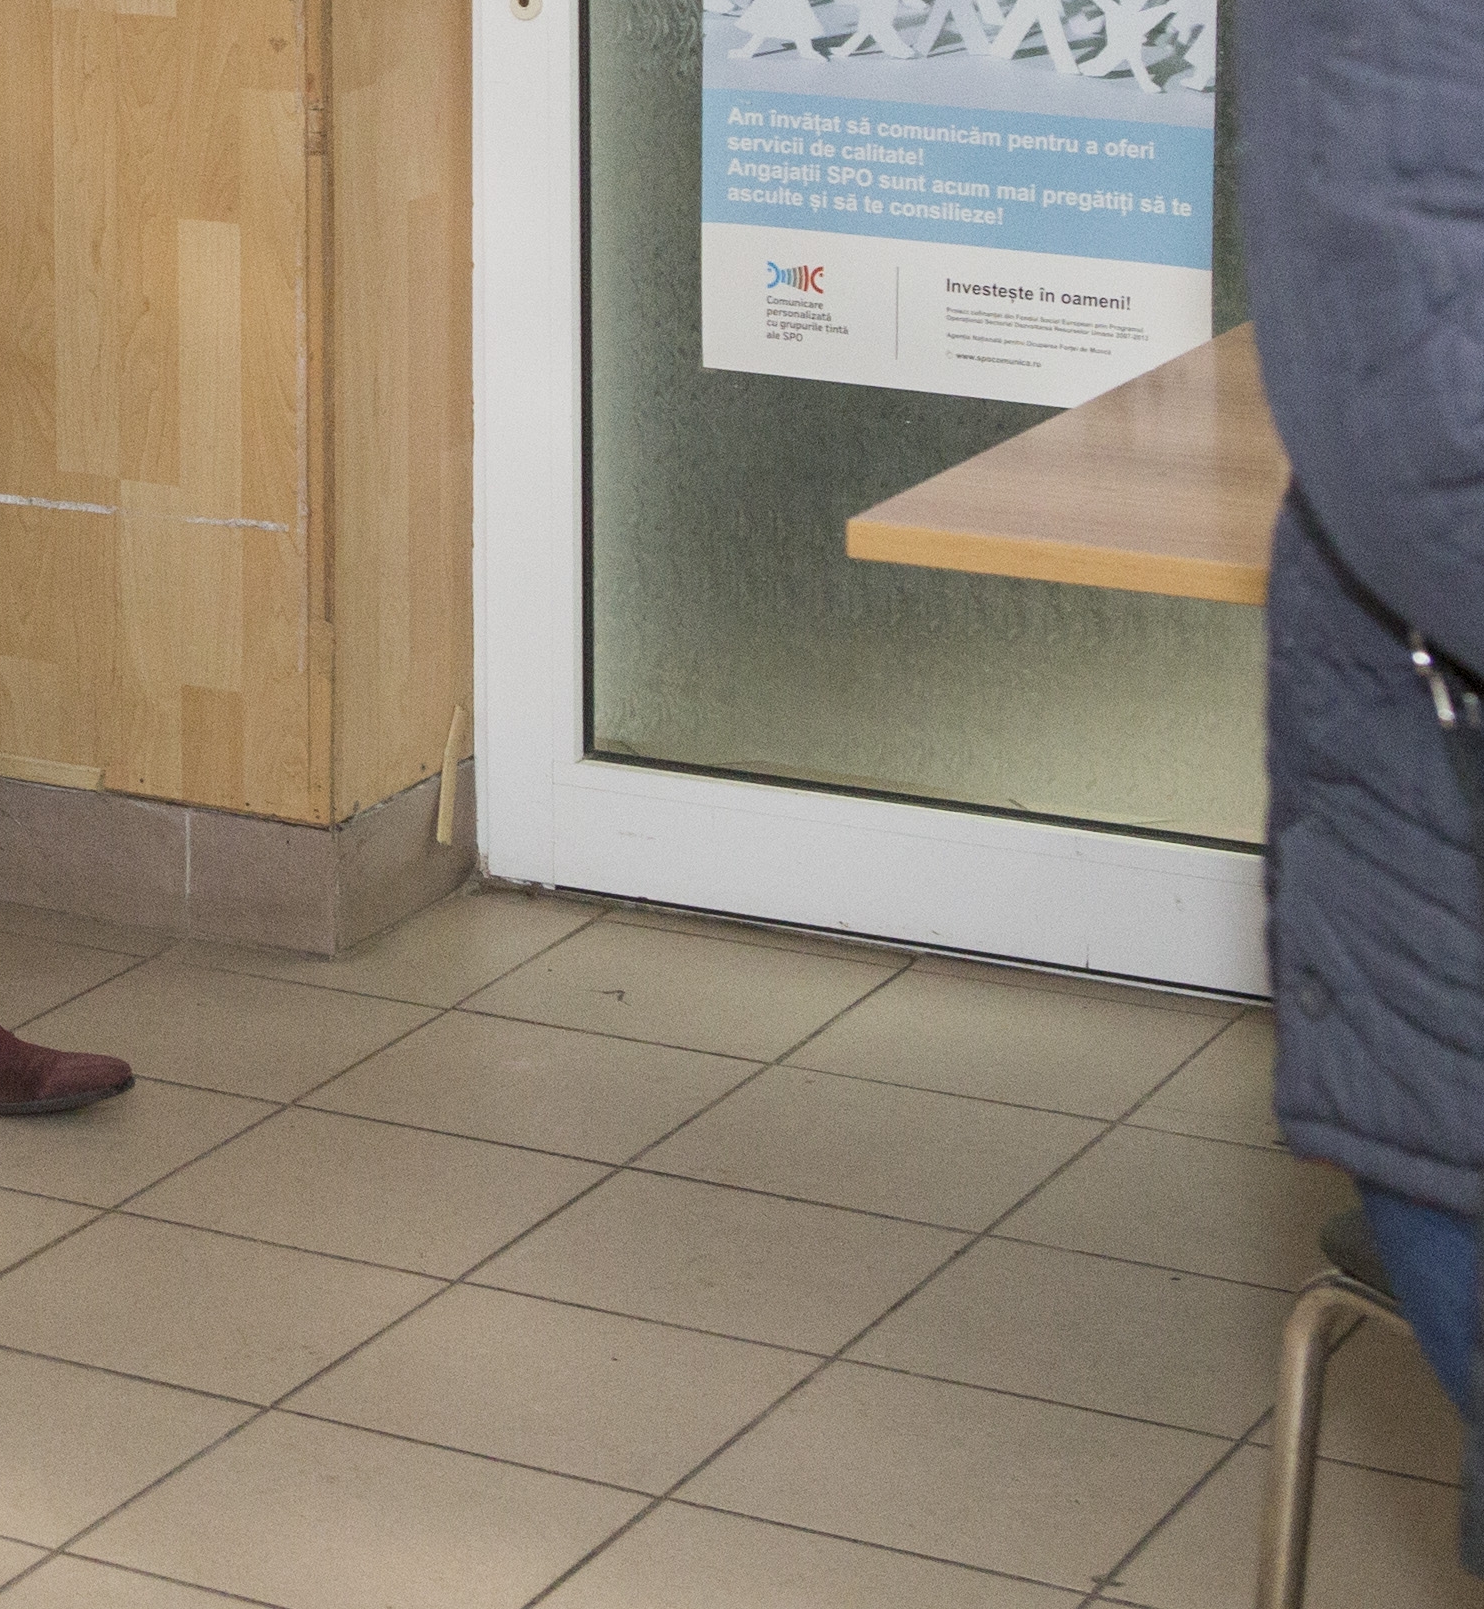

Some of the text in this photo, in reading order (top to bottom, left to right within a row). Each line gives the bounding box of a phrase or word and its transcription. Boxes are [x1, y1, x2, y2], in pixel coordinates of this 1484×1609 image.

[727, 108, 764, 126] Am
[846, 118, 871, 135] să
[877, 122, 1001, 147] comunicăm
[1008, 134, 1079, 153] pentru
[1086, 140, 1098, 155] a
[1104, 138, 1155, 159] oferi
[727, 136, 924, 166] servicii de calitate!
[727, 186, 804, 206] asculte
[833, 196, 858, 212] să
[863, 197, 884, 214] te
[889, 202, 1003, 225] consilieze!
[827, 166, 873, 187] SPO
[878, 174, 926, 193] sunt
[931, 179, 990, 198] acum
[997, 184, 1036, 202] mai
[1140, 195, 1166, 214] să
[1171, 198, 1192, 217] te
[766, 295, 824, 310] Comunicare
[1040, 287, 1055, 303] în
[1061, 293, 1131, 310] oameni!
[766, 330, 803, 342] ale SPO
